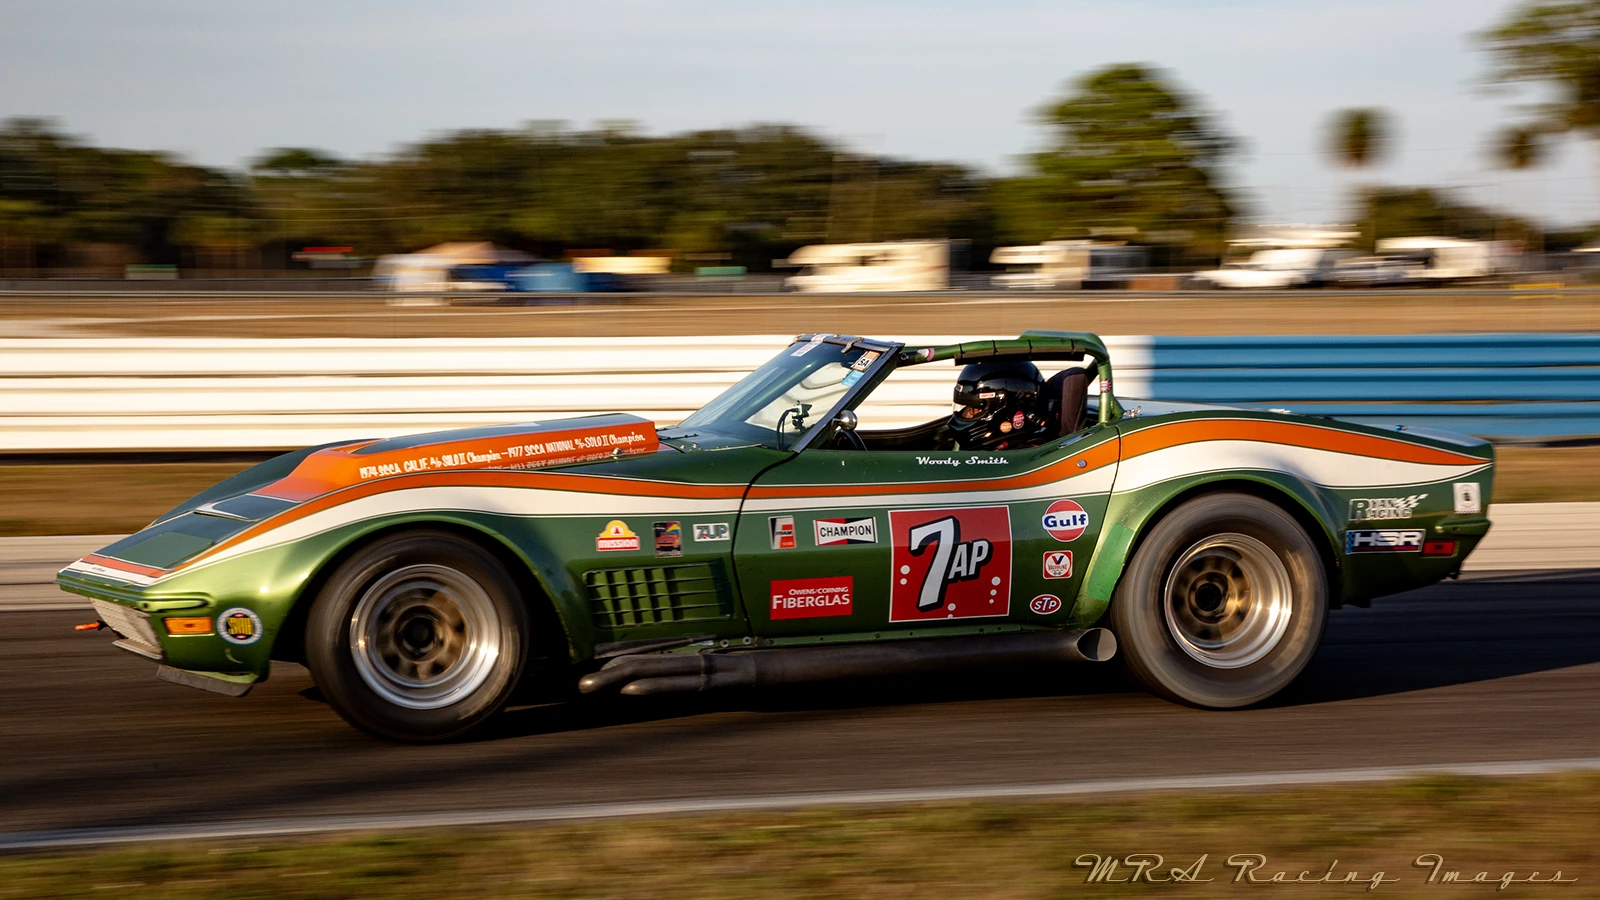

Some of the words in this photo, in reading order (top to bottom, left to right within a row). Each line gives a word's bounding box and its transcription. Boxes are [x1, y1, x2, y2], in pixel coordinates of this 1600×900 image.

[359, 464, 379, 479] 1974
[378, 463, 402, 477] SCCA
[403, 457, 431, 473] CALIF.
[442, 453, 461, 467] SOLO
[466, 449, 501, 463] Champion
[508, 445, 523, 458] 1977
[525, 443, 544, 457] SCCA
[545, 439, 576, 453] NATIONAL
[584, 435, 602, 448] SOLO
[609, 431, 646, 445] Champion
[916, 456, 961, 467] Woody
[965, 456, 1009, 465] Smith
[1043, 513, 1087, 528] Gulf
[696, 524, 727, 540] 7UP
[820, 525, 872, 537] CHAMPION
[1353, 531, 1423, 547] HSR
[909, 516, 957, 611] 7
[948, 539, 991, 580] AP
[788, 586, 849, 596] OWENS/CORNING
[772, 593, 850, 610] FIBERGLAS
[1033, 597, 1057, 611] STP
